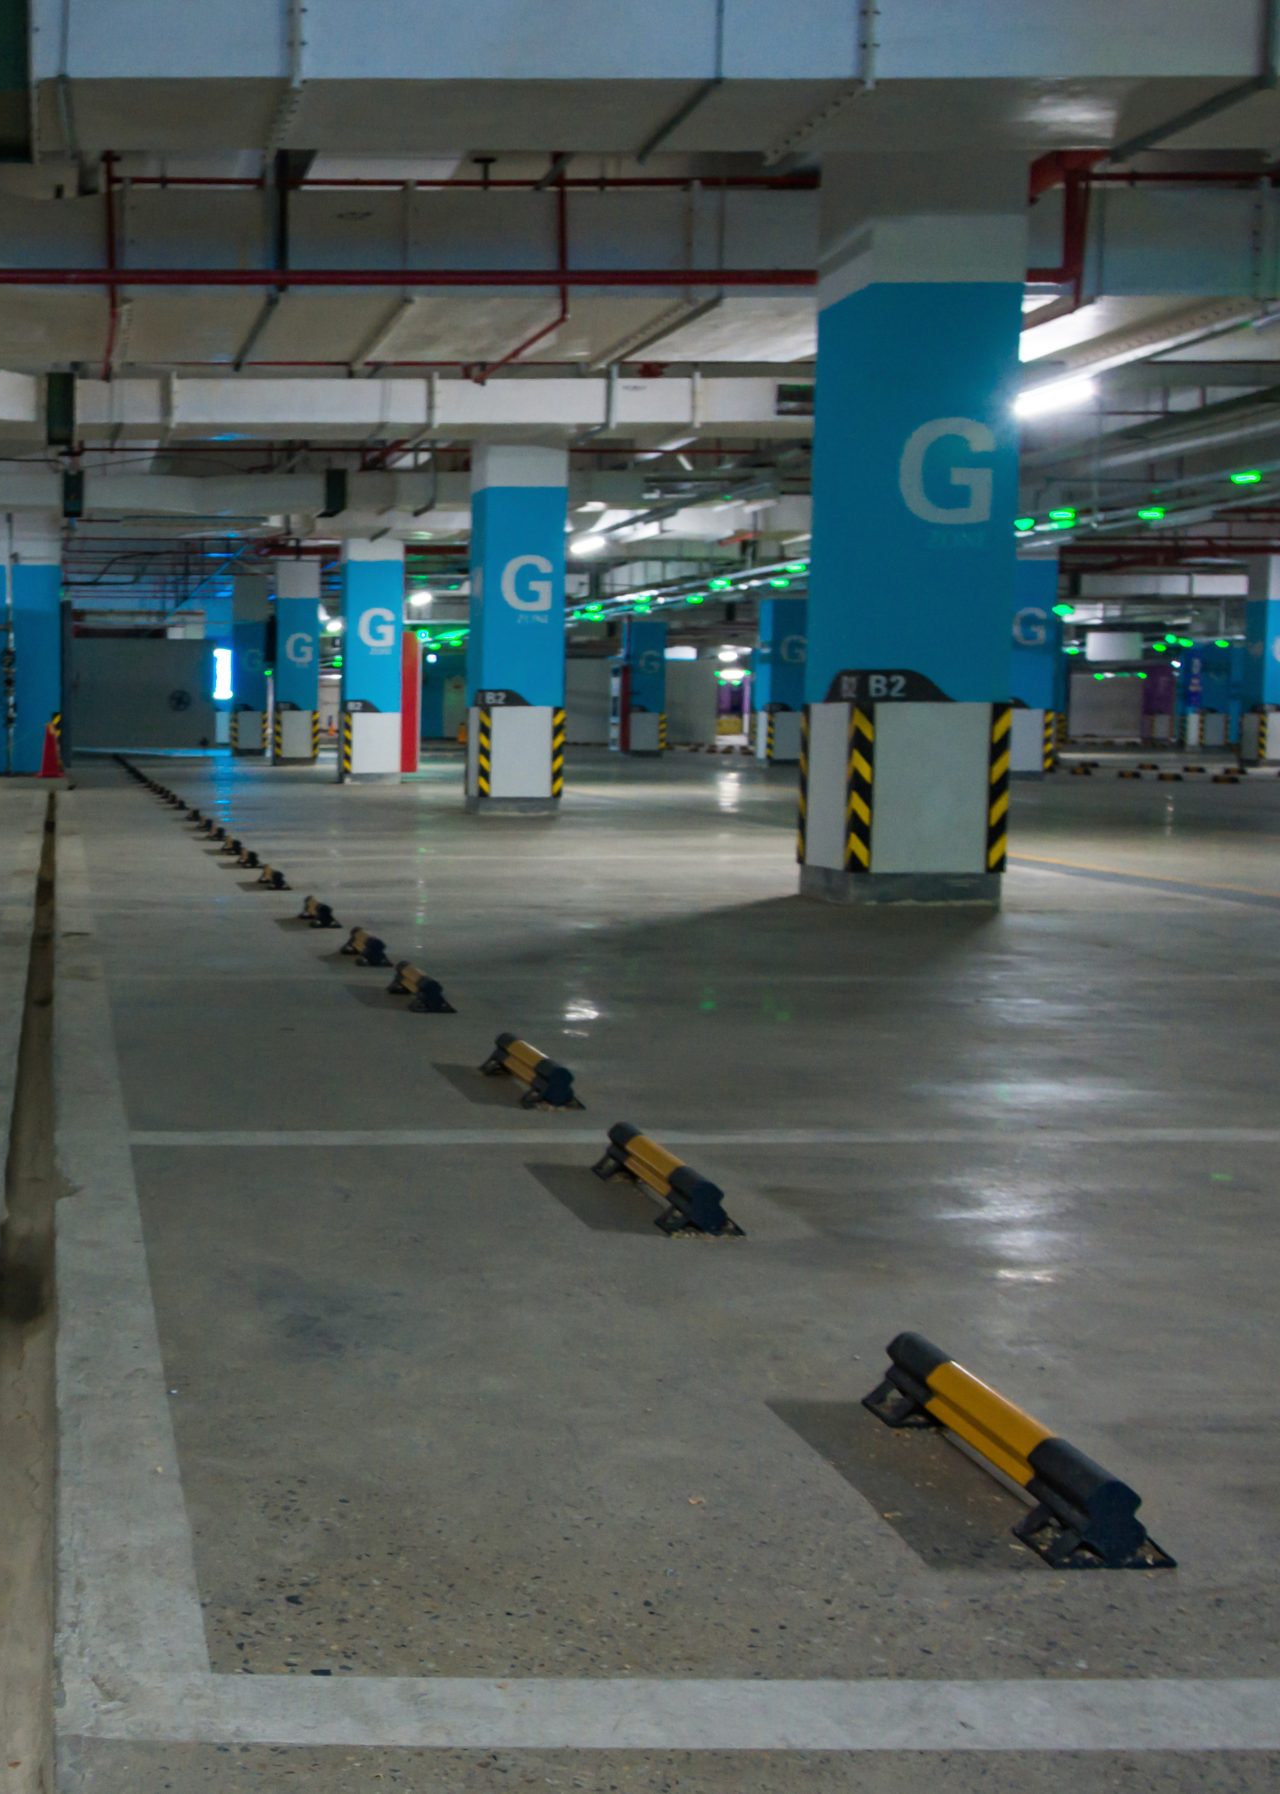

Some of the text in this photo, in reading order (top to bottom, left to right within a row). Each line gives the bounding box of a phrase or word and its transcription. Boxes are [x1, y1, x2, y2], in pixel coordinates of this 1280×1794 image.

[899, 416, 995, 525] G
[500, 554, 553, 612] G
[358, 607, 396, 648] G
[1013, 607, 1047, 645] G
[286, 632, 313, 664] G
[781, 635, 807, 664] G
[485, 692, 506, 704] B2
[868, 674, 906, 698] B2
